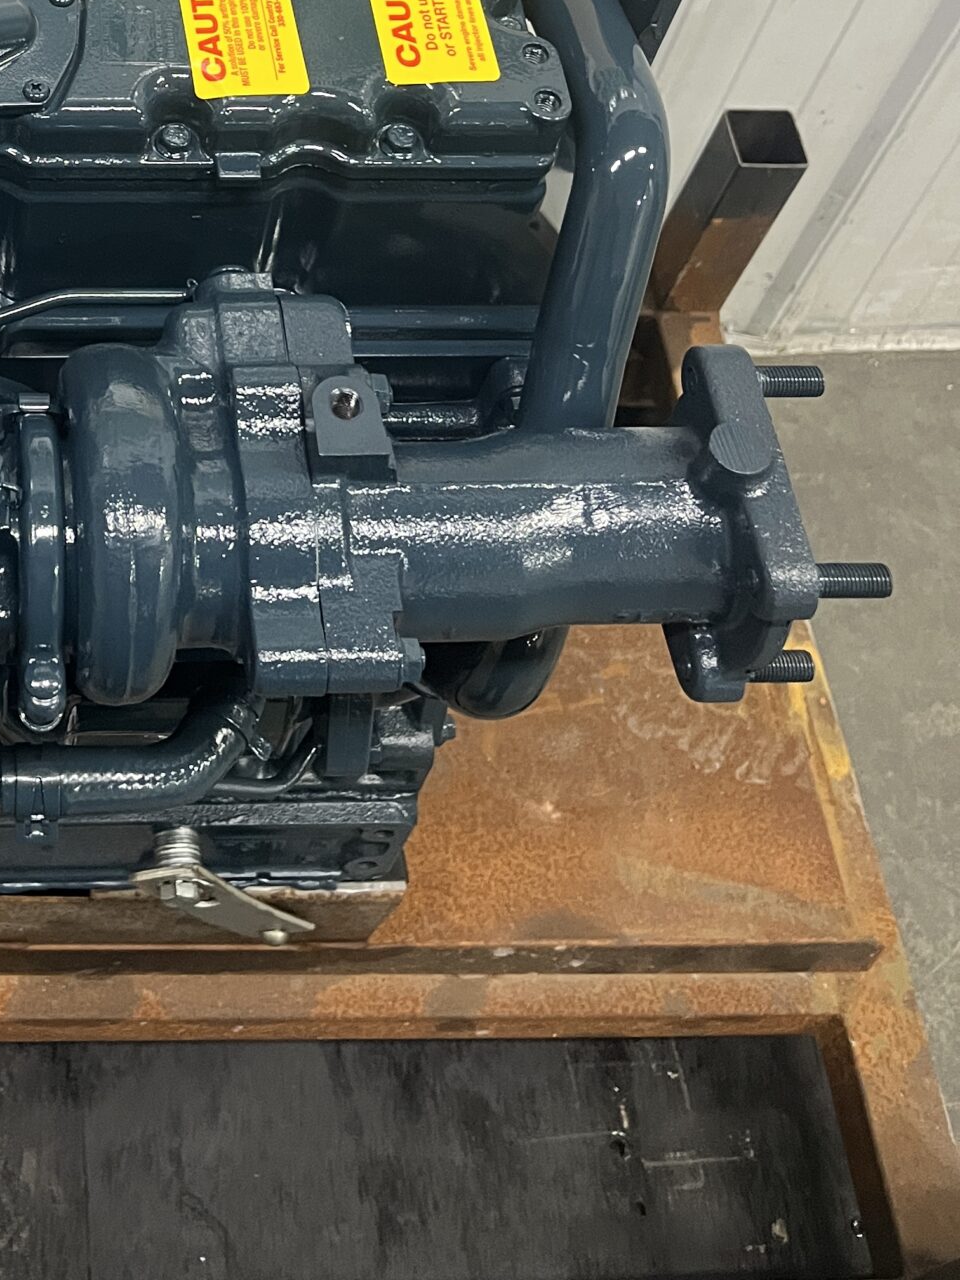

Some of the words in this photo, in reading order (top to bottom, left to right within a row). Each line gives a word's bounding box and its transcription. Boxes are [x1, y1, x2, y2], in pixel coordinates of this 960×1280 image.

[418, 9, 434, 29] not
[422, 33, 438, 50] Do
[444, 43, 457, 56] or
